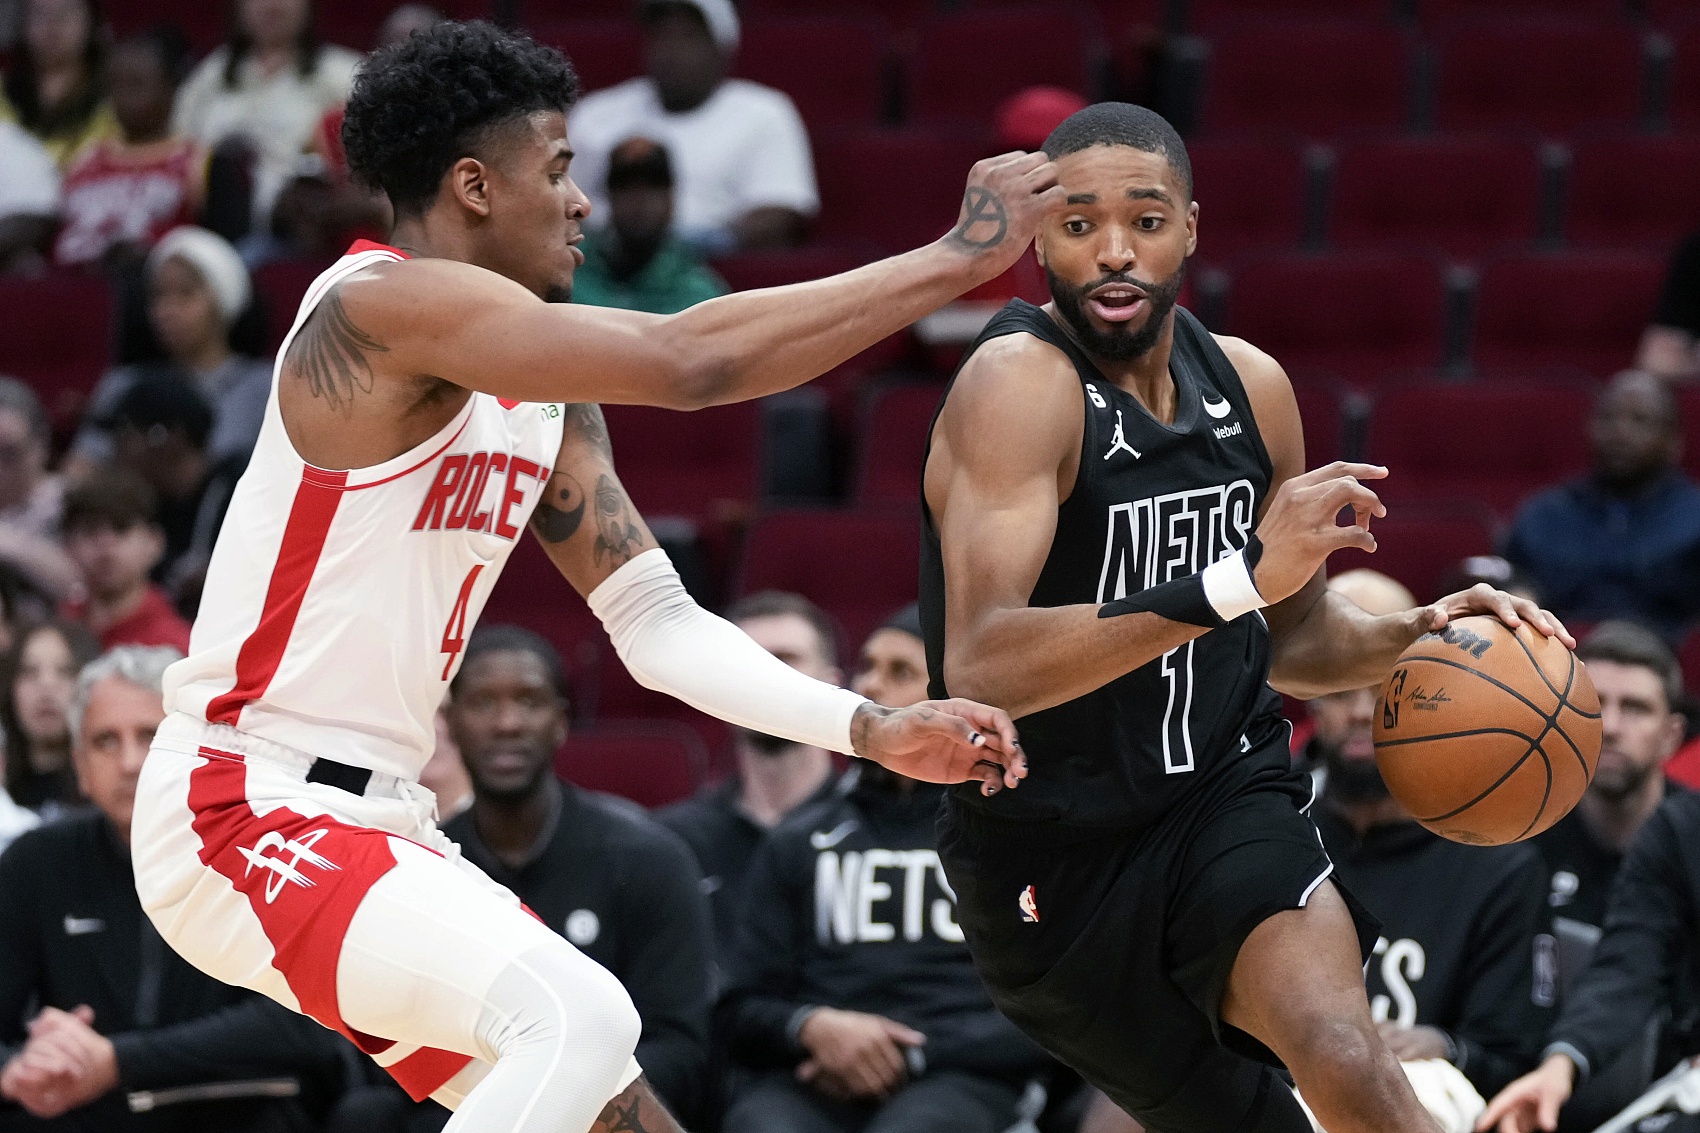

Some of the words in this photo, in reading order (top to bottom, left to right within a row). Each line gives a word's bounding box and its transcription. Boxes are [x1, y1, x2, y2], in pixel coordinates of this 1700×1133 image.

[1085, 383, 1107, 408] 6
[1212, 421, 1242, 440] Webull
[1096, 479, 1255, 604] NETS
[440, 564, 485, 681] 4
[1161, 638, 1195, 775] 1
